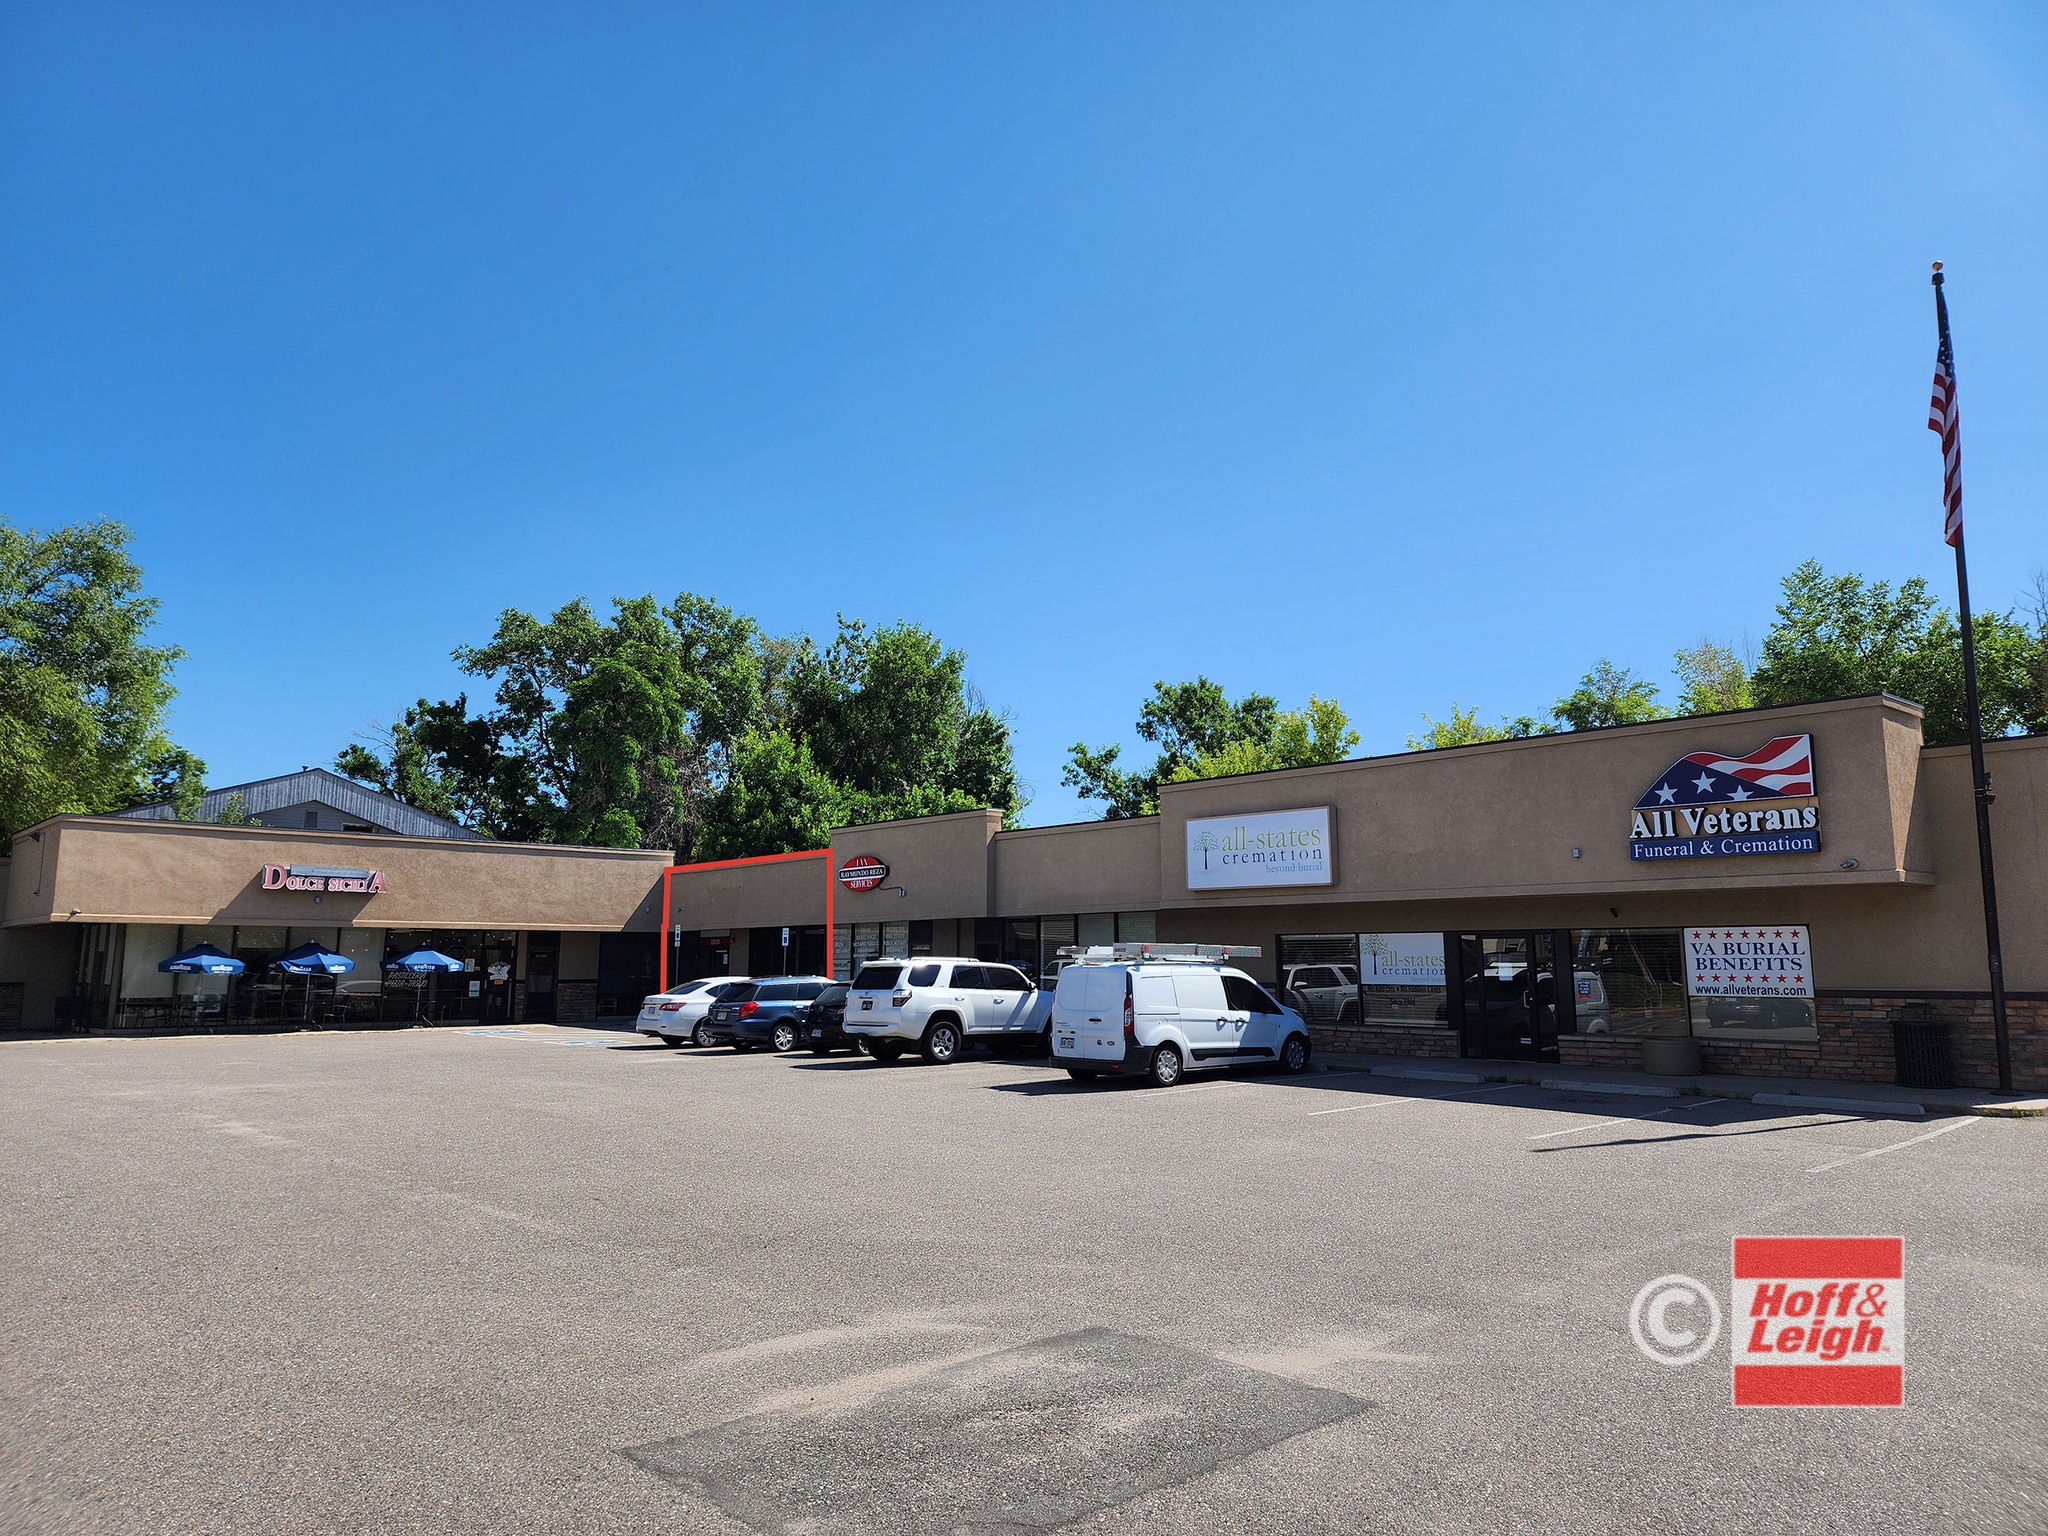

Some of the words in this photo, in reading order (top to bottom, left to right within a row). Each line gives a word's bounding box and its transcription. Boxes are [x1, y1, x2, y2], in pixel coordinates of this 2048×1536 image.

[1629, 811, 1677, 839] All
[1680, 806, 1817, 836] Veterans
[1222, 826, 1321, 852] all-states
[1634, 841, 1693, 858] Funeral
[1700, 840, 1715, 855] &
[1721, 835, 1813, 854] Cremation
[1222, 848, 1322, 865] cremation
[841, 869, 869, 878] RAYMUNDO
[870, 868, 883, 876] REZA
[1266, 863, 1295, 875] beyond
[1298, 862, 1322, 871] burial
[850, 879, 873, 888] SERVICES
[1690, 942, 1717, 955] VA
[1722, 942, 1805, 955] BURIAL
[1382, 951, 1445, 967] all-states
[1695, 957, 1803, 971] BENEFITS
[1382, 967, 1446, 975] cremation
[1695, 984, 1807, 996] www.allveterans.com
